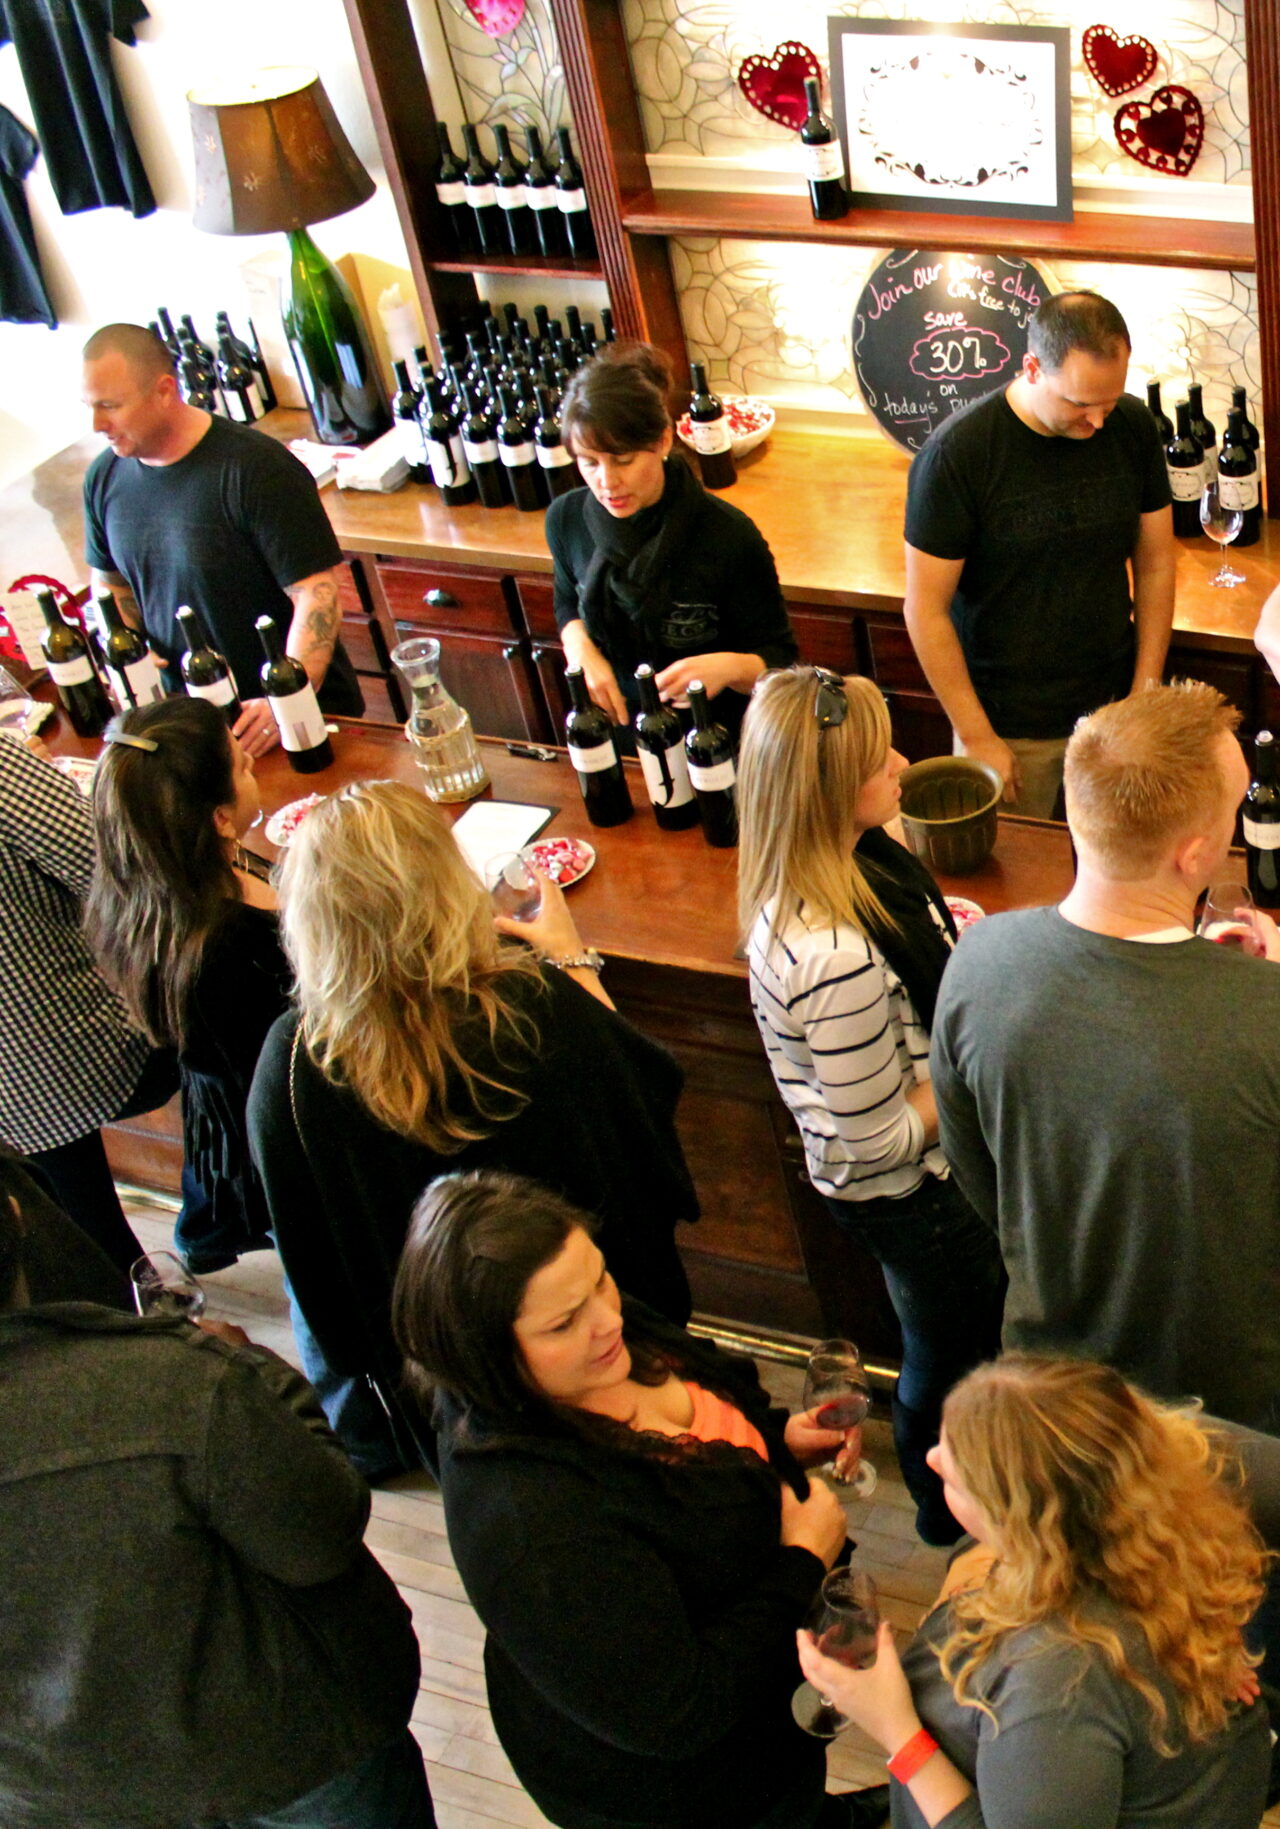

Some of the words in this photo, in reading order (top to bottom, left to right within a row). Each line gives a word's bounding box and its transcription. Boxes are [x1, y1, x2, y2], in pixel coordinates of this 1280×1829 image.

[868, 277, 913, 320] Join
[913, 263, 944, 289] our
[1001, 271, 1041, 306] club
[978, 285, 1005, 310] free
[1007, 299, 1021, 317] to
[924, 311, 968, 331] save
[929, 336, 987, 373] 30%
[940, 384, 958, 397] on
[883, 390, 938, 434] today's
